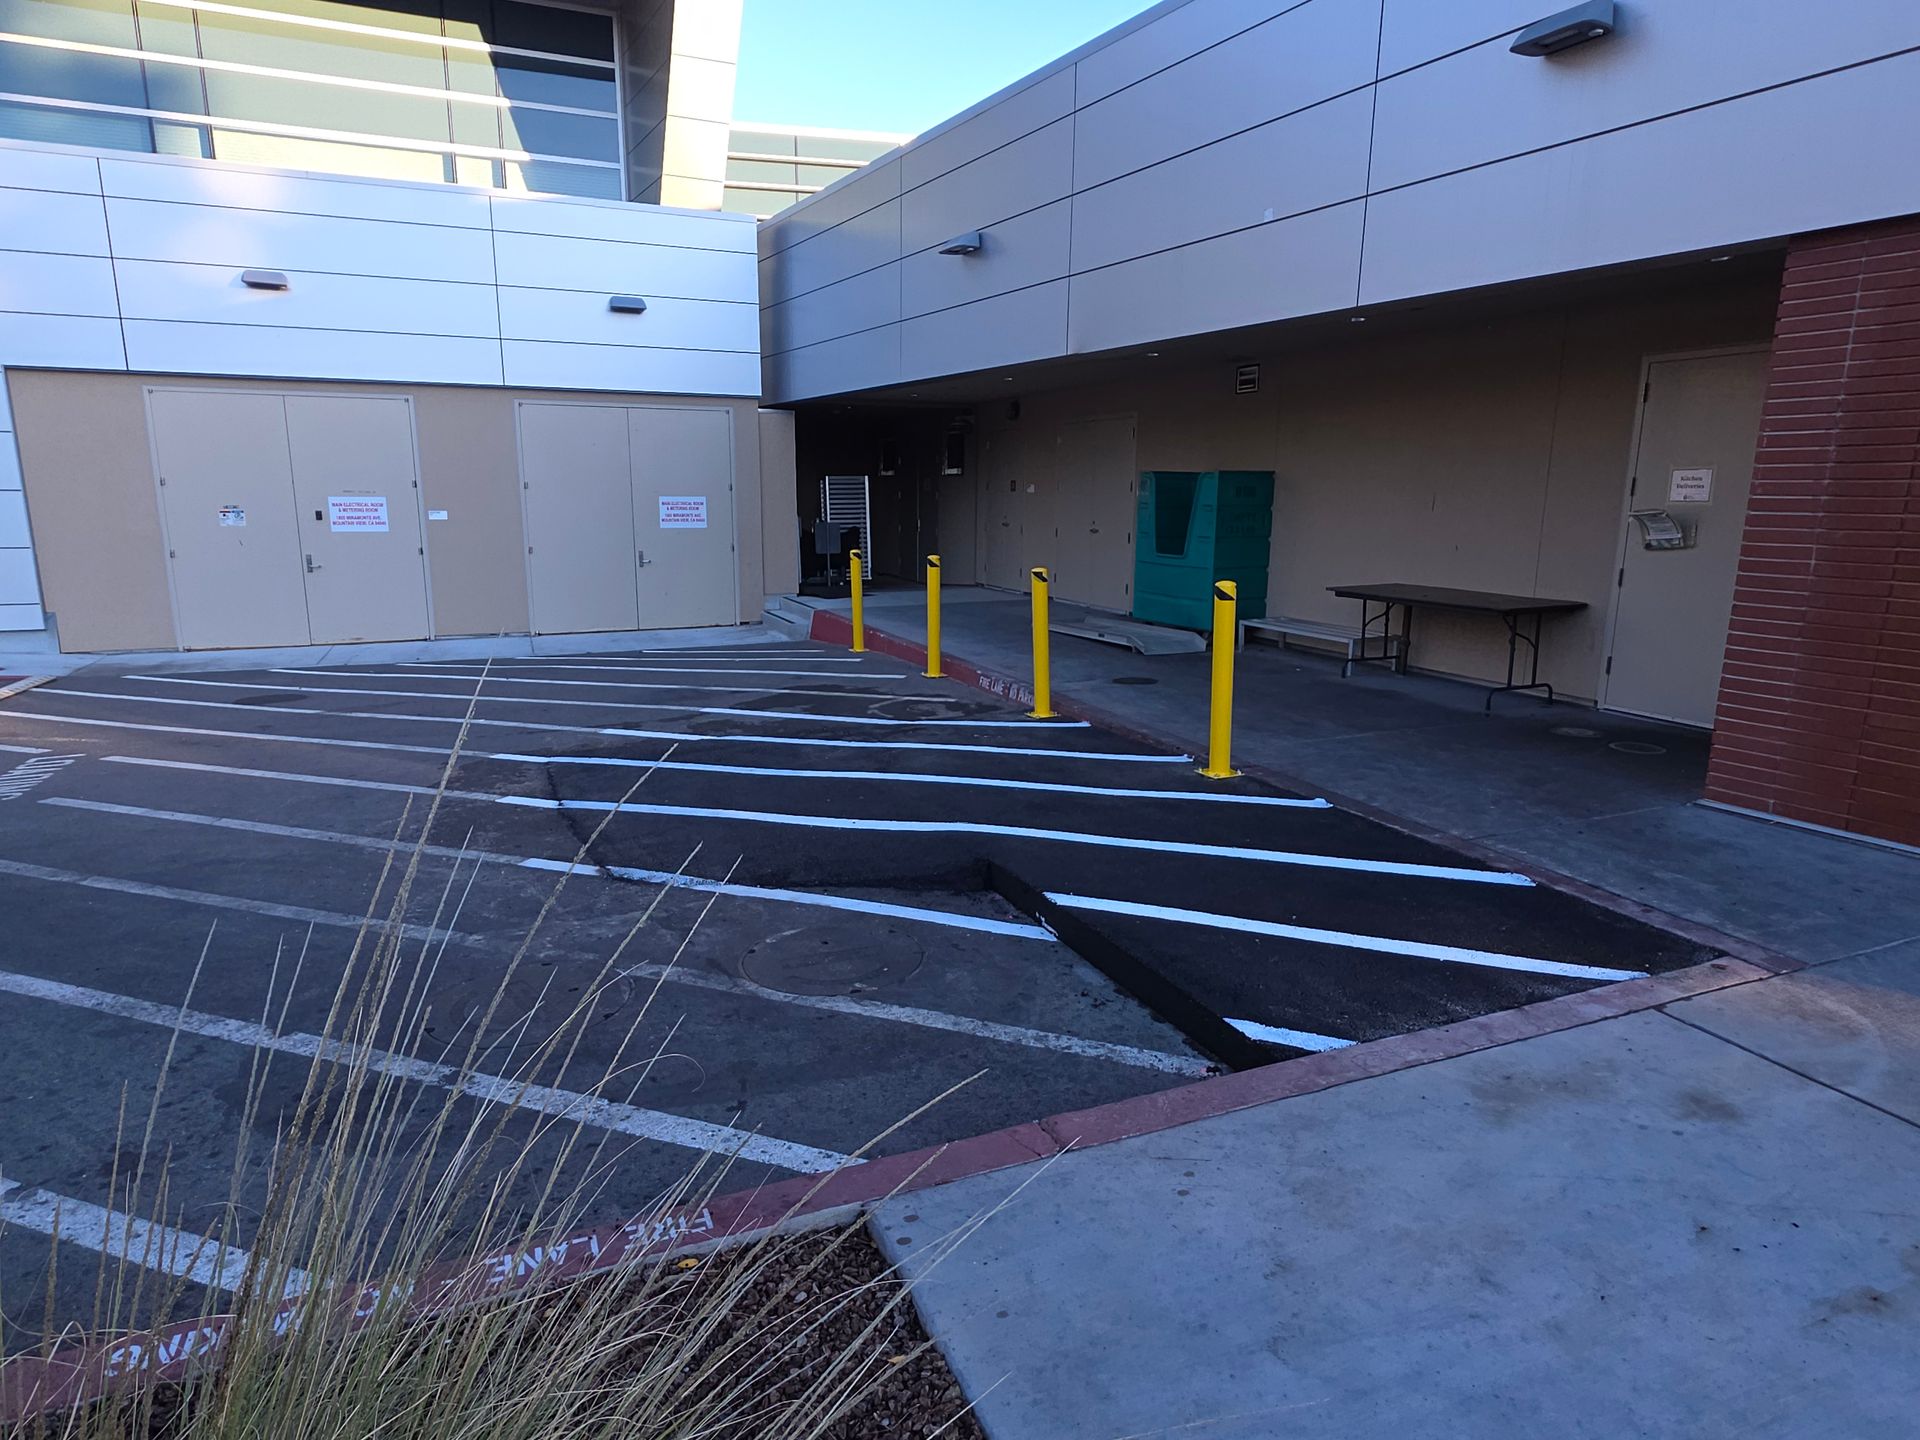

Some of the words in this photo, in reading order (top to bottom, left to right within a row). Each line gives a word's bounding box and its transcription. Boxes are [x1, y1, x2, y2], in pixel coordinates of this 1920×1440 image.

[979, 675, 991, 690] FIRE
[990, 677, 1004, 696] LANE
[624, 1208, 714, 1251] FIRE
[485, 1234, 600, 1283] LANE
